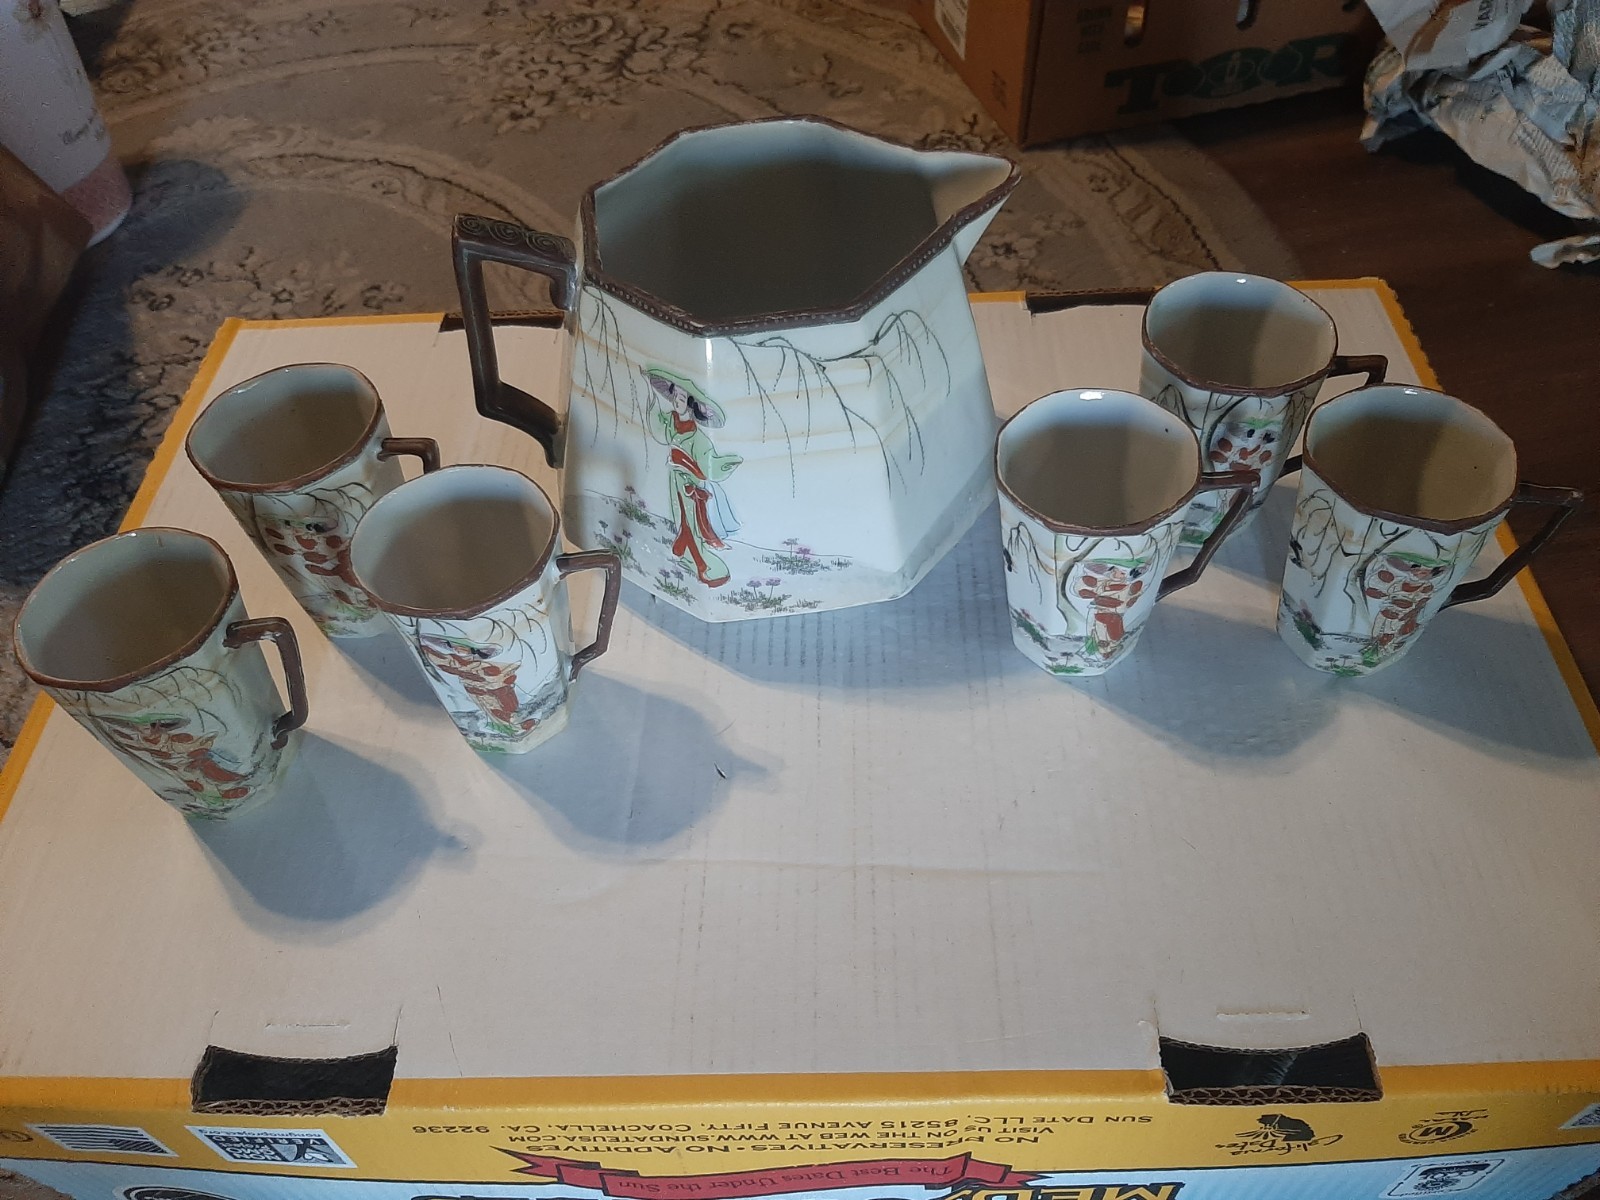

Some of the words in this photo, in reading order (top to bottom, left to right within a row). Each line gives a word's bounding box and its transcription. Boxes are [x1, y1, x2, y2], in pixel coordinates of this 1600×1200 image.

[1033, 1116, 1093, 1125] DATE
[1105, 1115, 1152, 1124] SUN
[777, 1121, 873, 1131] AVENUE
[881, 1119, 959, 1130] 85215
[412, 1125, 490, 1134] 92236
[964, 1125, 992, 1134] US
[998, 1125, 1055, 1134] VISIT
[786, 1134, 813, 1142] AT
[820, 1133, 872, 1141] WEB
[877, 1131, 922, 1139] THE
[927, 1130, 958, 1139] ON
[211, 1136, 321, 1145] VERIFIED
[751, 1136, 985, 1152] PRESERVATIVES
[1215, 1139, 1277, 1151] Dates
[1229, 1134, 1344, 1155] California
[225, 1147, 275, 1155] GMO
[525, 1145, 680, 1154] ADDITIVES
[232, 1152, 282, 1161] NON
[781, 1170, 844, 1182] Dates
[850, 1167, 901, 1178] Best
[909, 1166, 953, 1177] The
[618, 1182, 660, 1193] Sun
[665, 1182, 702, 1192] the
[710, 1177, 778, 1189] Under
